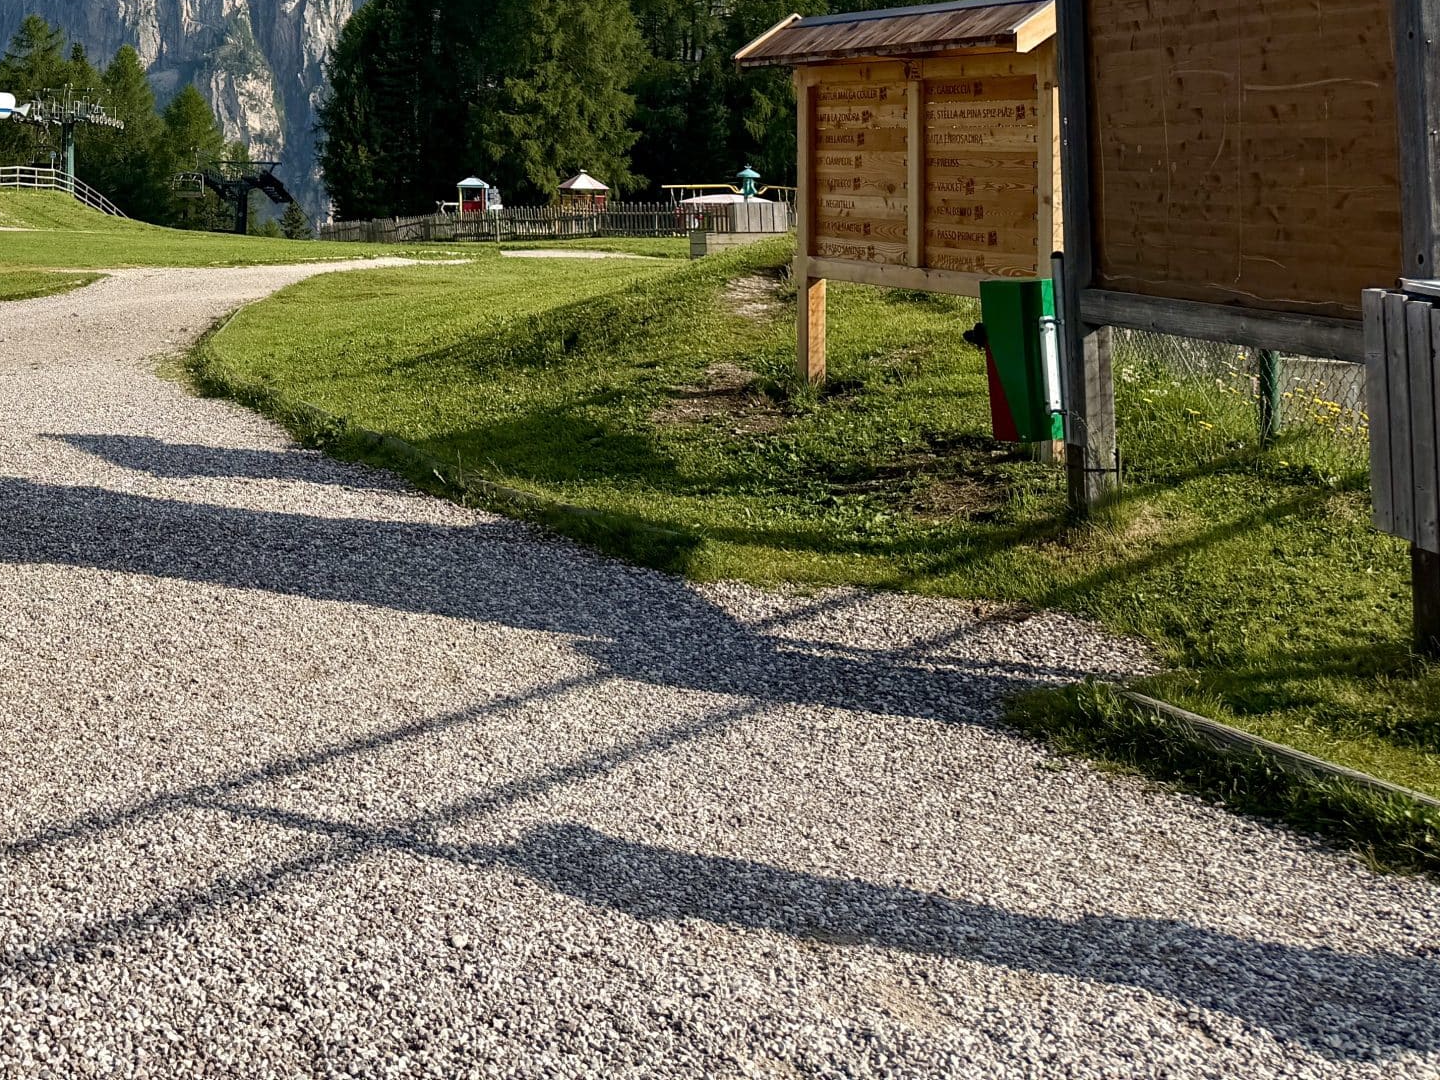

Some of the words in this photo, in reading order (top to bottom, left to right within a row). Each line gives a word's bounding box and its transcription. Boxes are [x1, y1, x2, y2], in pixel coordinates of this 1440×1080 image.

[937, 109, 958, 119] STELLA
[960, 108, 981, 119] ALPINA
[937, 230, 956, 241] PASSO
